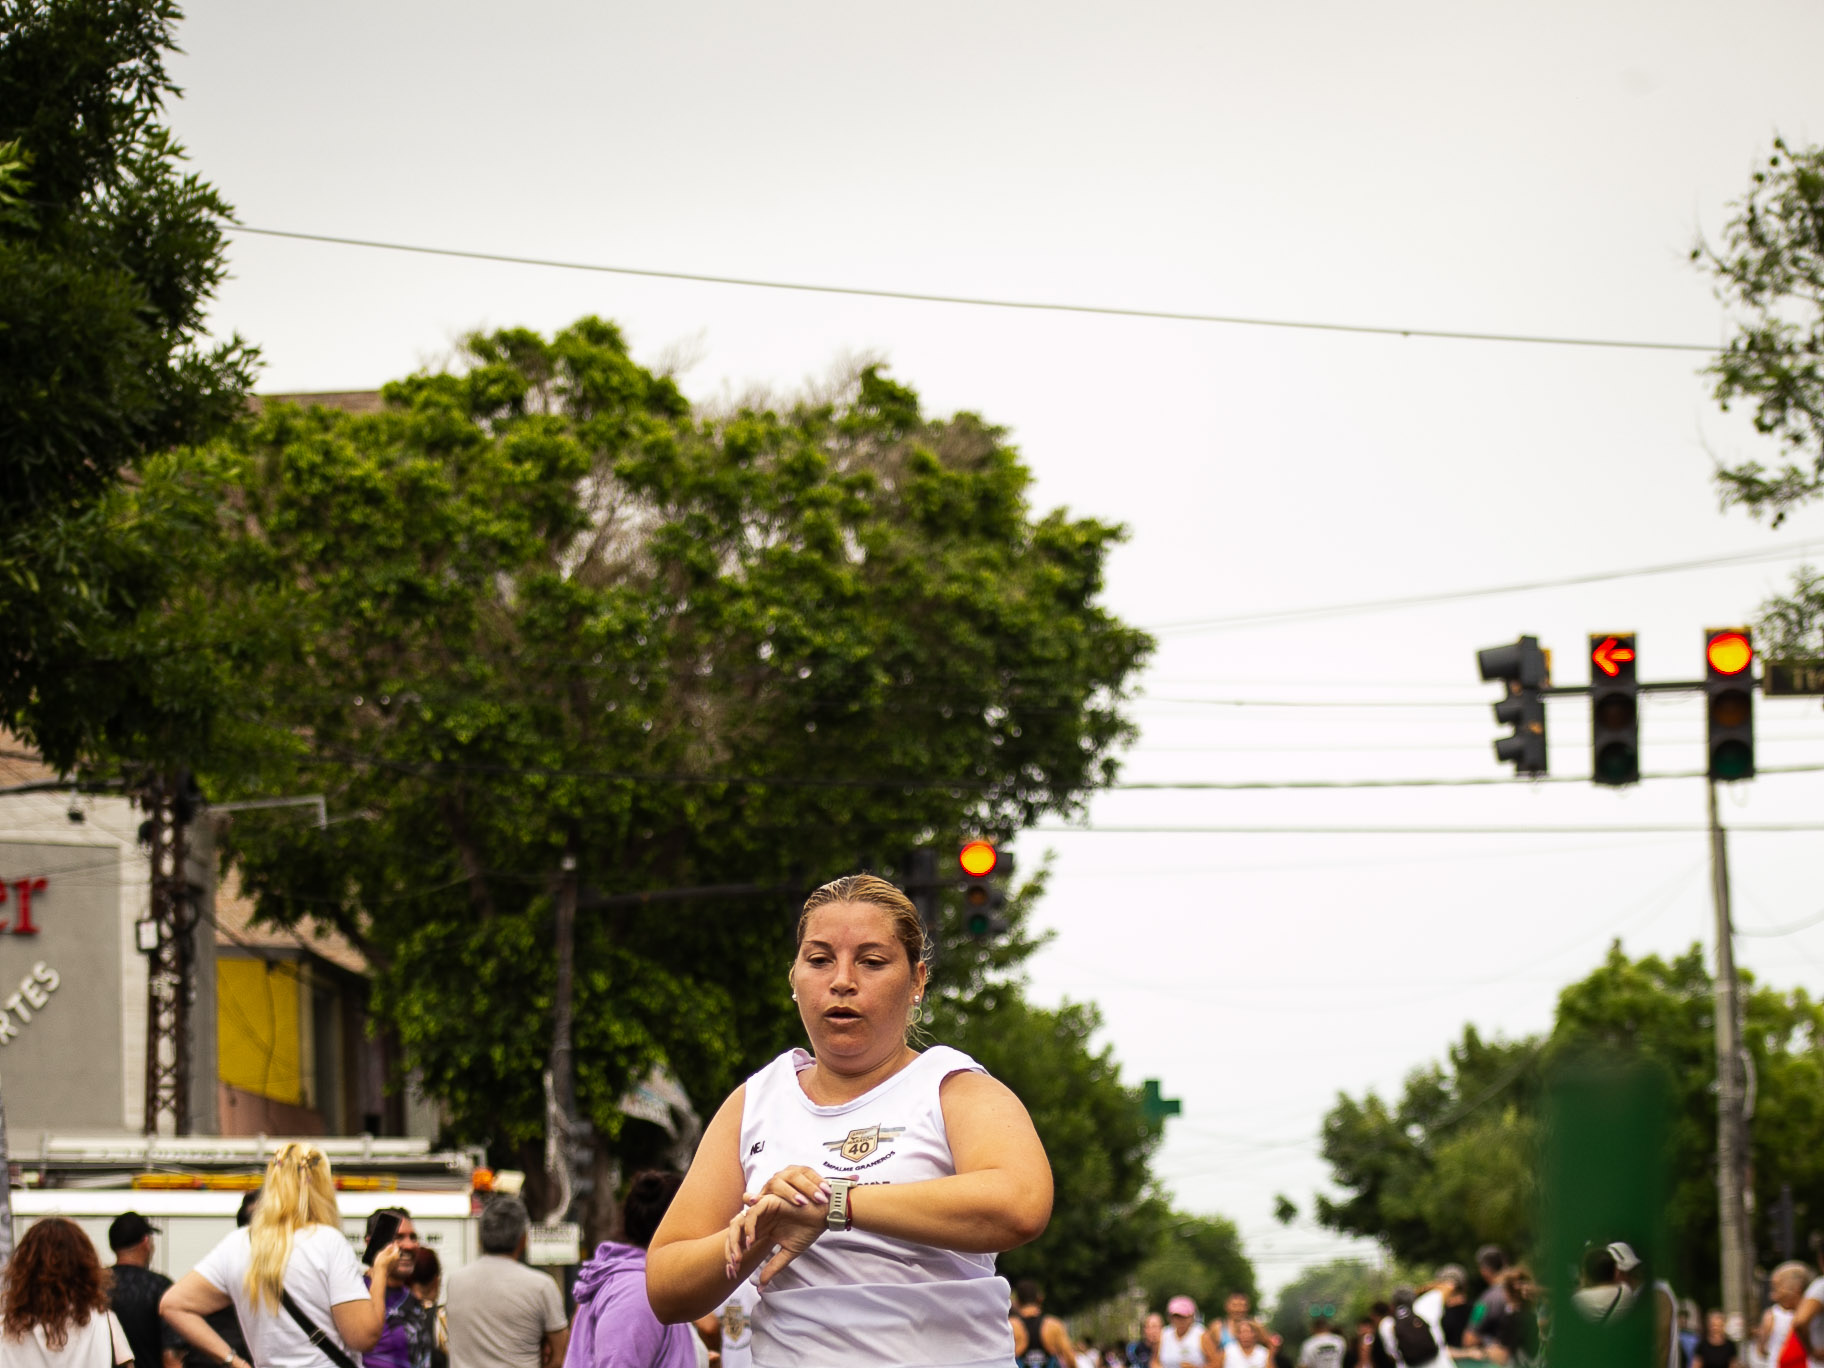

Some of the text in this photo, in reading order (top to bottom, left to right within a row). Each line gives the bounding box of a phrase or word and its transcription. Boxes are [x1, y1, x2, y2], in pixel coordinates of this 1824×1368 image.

[848, 1141, 870, 1155] 40
[822, 1150, 896, 1172] EMPALME GRANEROS
